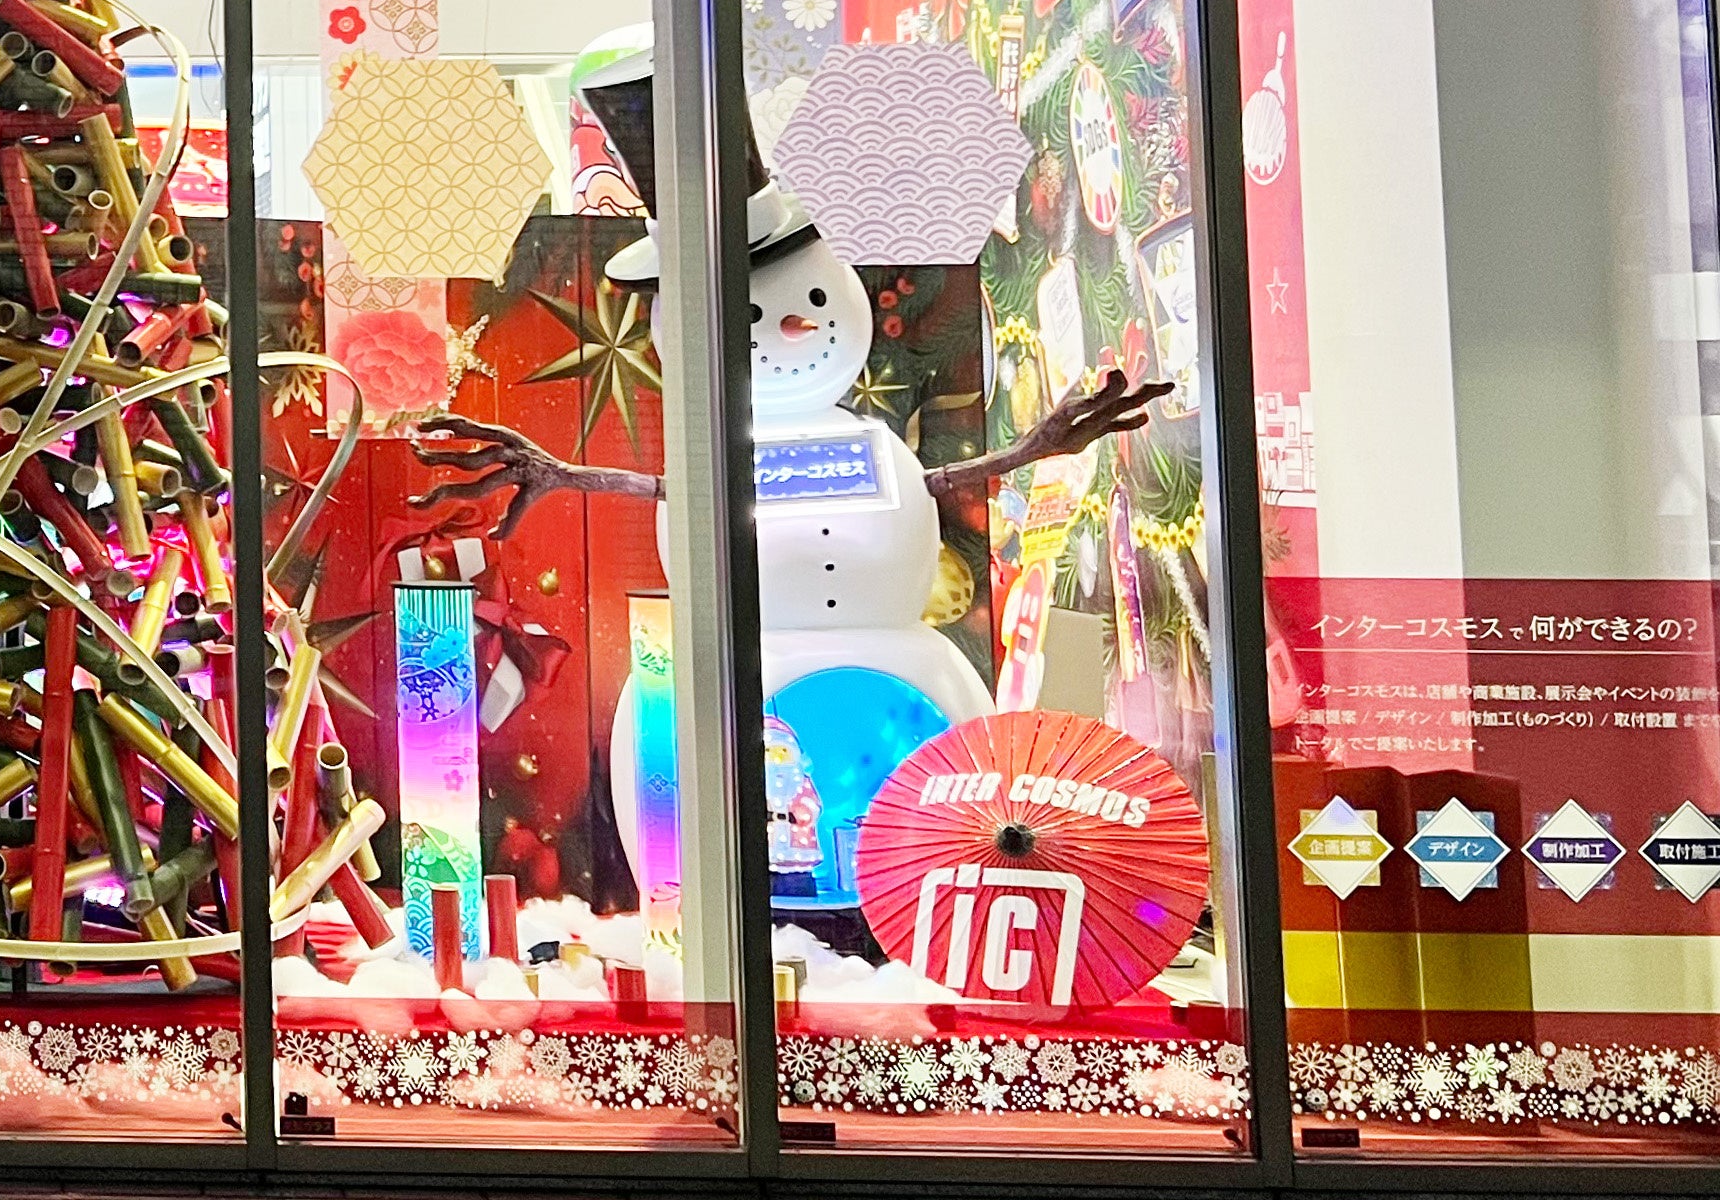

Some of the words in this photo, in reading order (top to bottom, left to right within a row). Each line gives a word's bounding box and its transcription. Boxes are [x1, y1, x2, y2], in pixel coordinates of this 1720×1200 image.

[1374, 709, 1432, 726] デザイン
[918, 772, 1002, 807] INTER
[1008, 773, 1151, 828] COSMOS
[1427, 841, 1485, 857] デザイン
[1541, 842, 1606, 859] 制作加工
[1658, 843, 1720, 861] 取付施工
